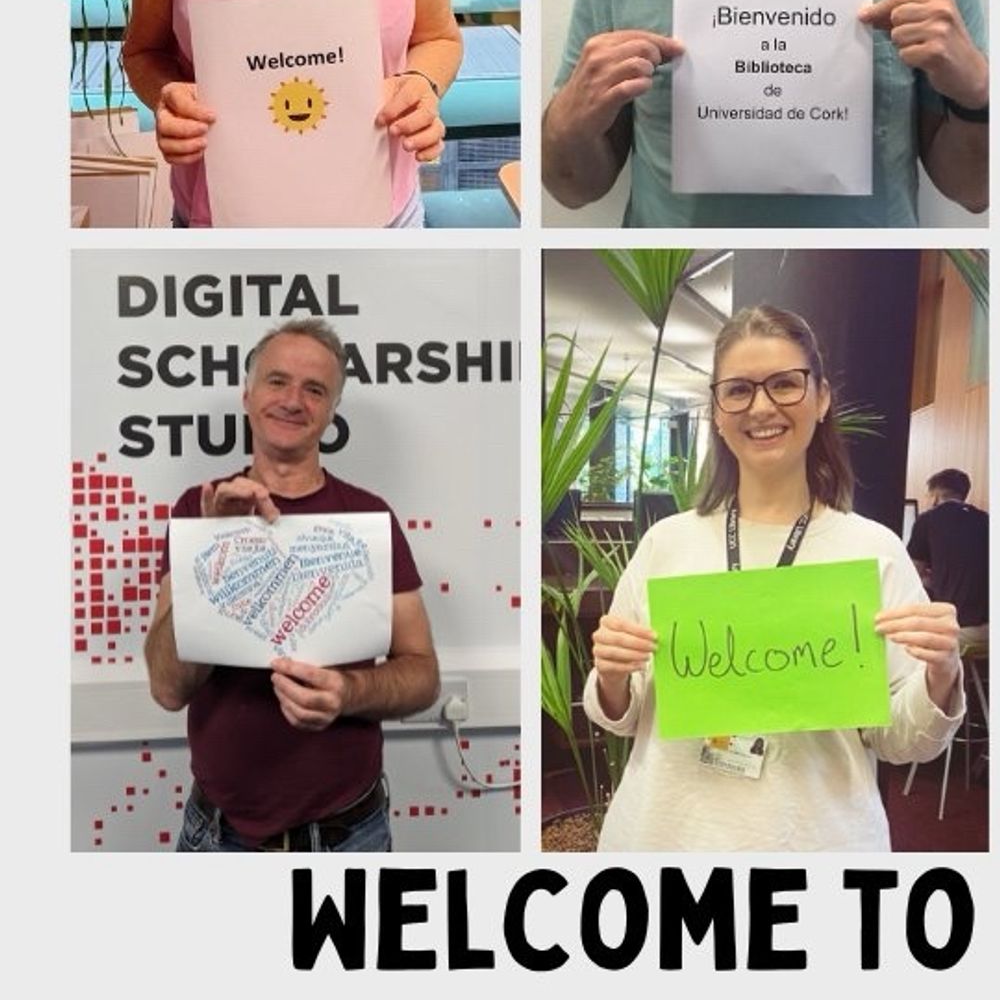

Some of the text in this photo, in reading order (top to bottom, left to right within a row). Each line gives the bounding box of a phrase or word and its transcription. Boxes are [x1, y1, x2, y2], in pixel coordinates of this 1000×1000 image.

[761, 38, 787, 51] a la
[246, 46, 345, 71] Welcome!
[735, 60, 812, 74] Biblioteca
[763, 84, 782, 97] de
[697, 106, 849, 121] Universidad de Cork!
[117, 273, 360, 318] DIGITAL
[118, 413, 350, 458] STUO
[270, 575, 331, 645] welcome
[670, 603, 865, 679] Welcome!
